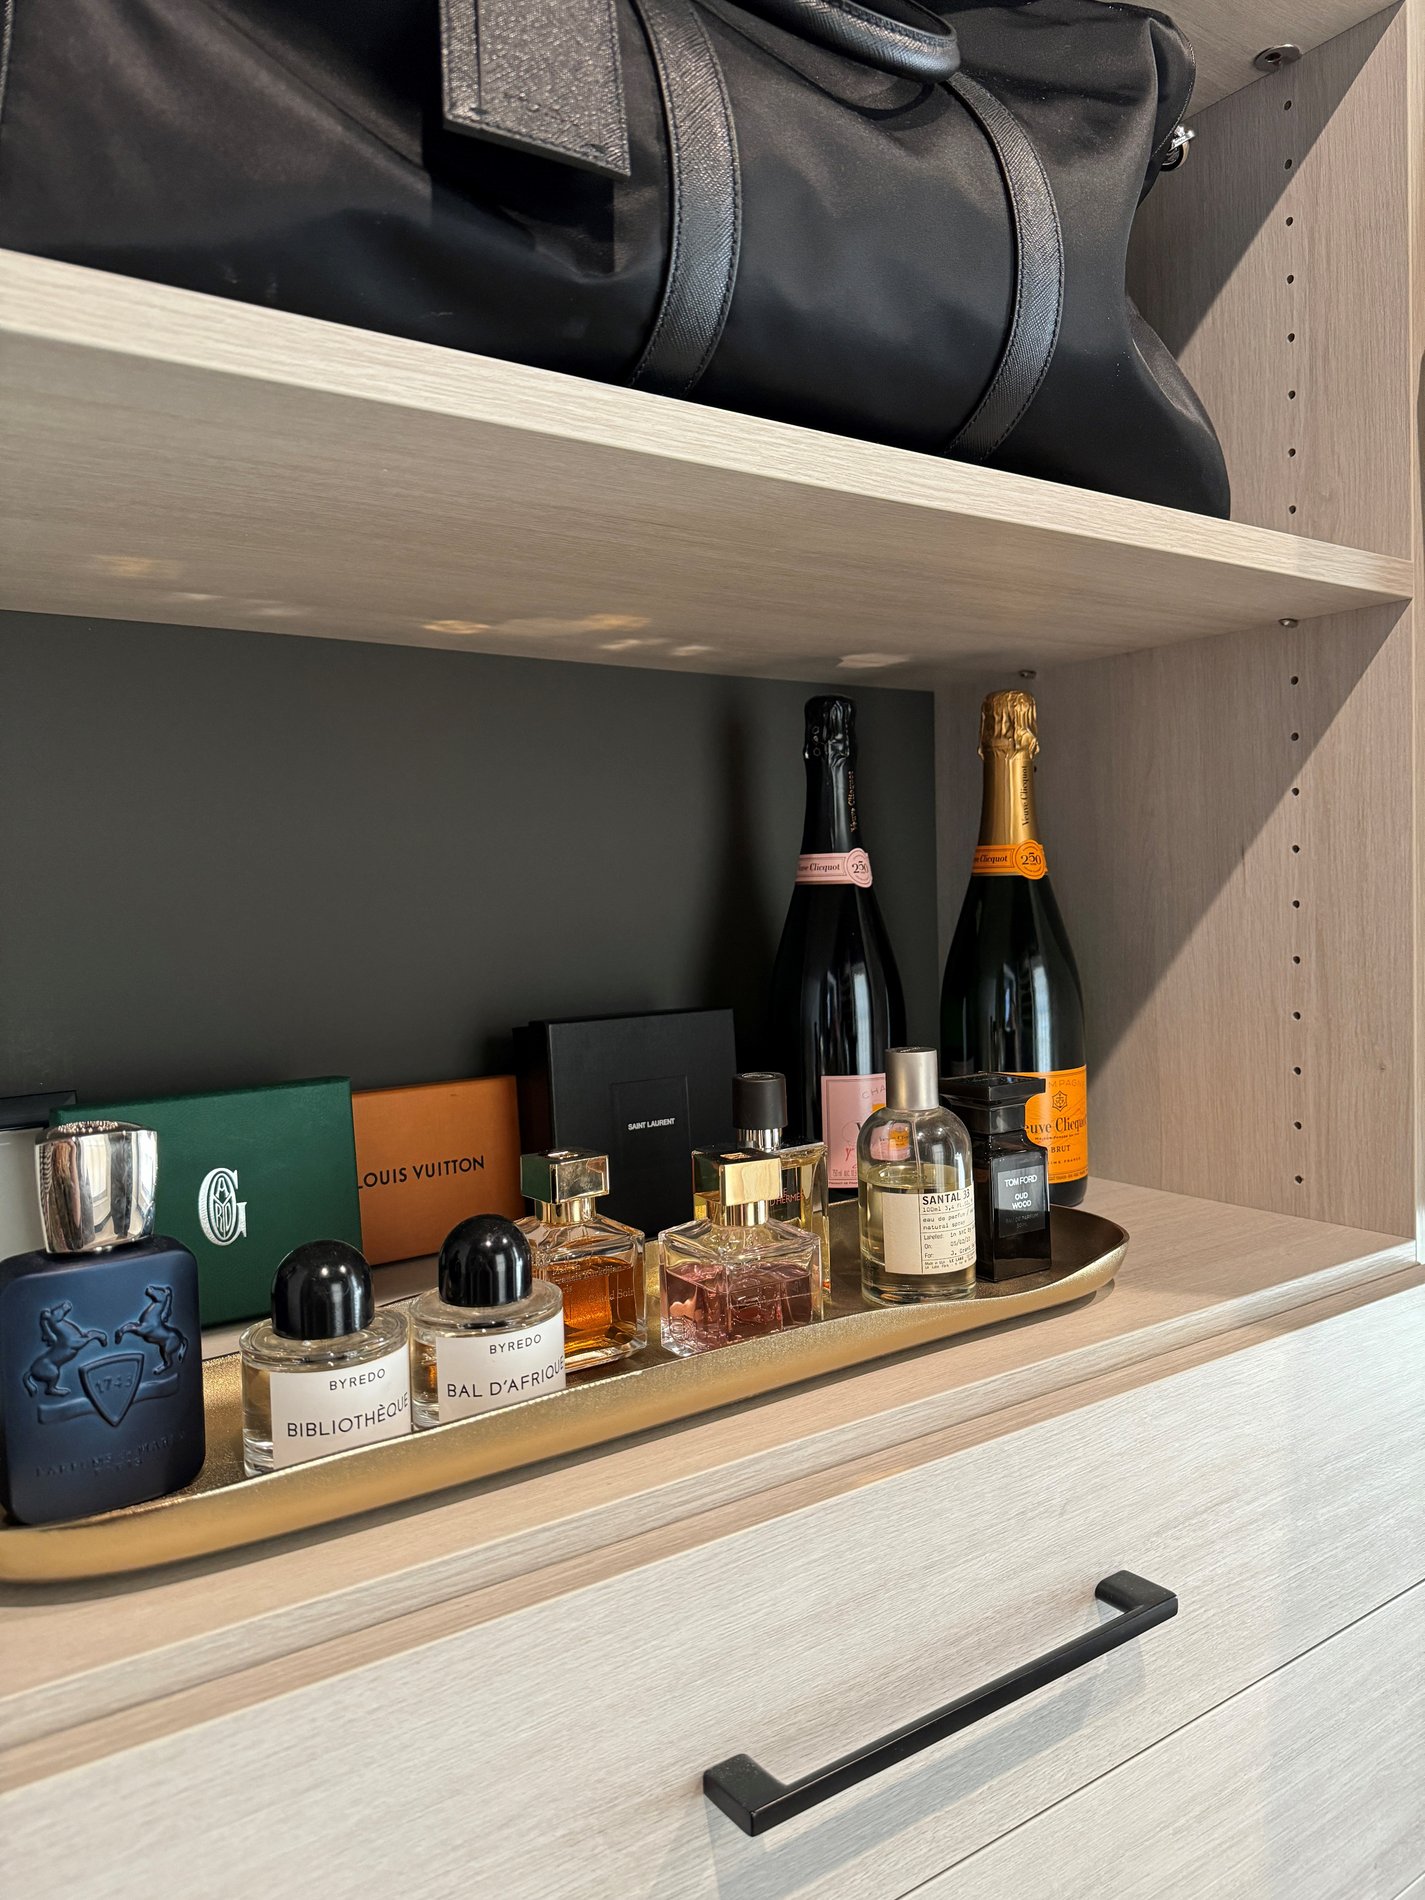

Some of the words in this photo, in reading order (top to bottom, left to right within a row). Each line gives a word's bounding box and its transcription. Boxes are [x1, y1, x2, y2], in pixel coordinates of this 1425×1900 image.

[1019, 765, 1029, 801] Clicquot
[1021, 802, 1030, 827] Veuve
[979, 854, 1008, 865] Clicquot
[1020, 852, 1042, 866] 250
[809, 862, 841, 873] Clicquot
[852, 860, 869, 875] 250
[627, 1121, 647, 1131] SAINT
[647, 1117, 676, 1128] LAURENT
[1025, 1123, 1052, 1135] euve
[1050, 1144, 1071, 1154] BRUT
[412, 1155, 485, 1180] VUITTON
[1004, 1177, 1020, 1188] TOM
[1020, 1174, 1038, 1185] FORD
[922, 1191, 961, 1206] SANTAL
[963, 1188, 970, 1200] 33
[1014, 1191, 1029, 1201] OUD
[1011, 1199, 1032, 1210] WOOD
[922, 1222, 949, 1230] natural
[489, 1333, 542, 1355] BYREDO
[329, 1367, 386, 1391] BYREDO
[446, 1383, 483, 1398] BAL
[287, 1391, 409, 1438] BIBLIOTHÈQUE
